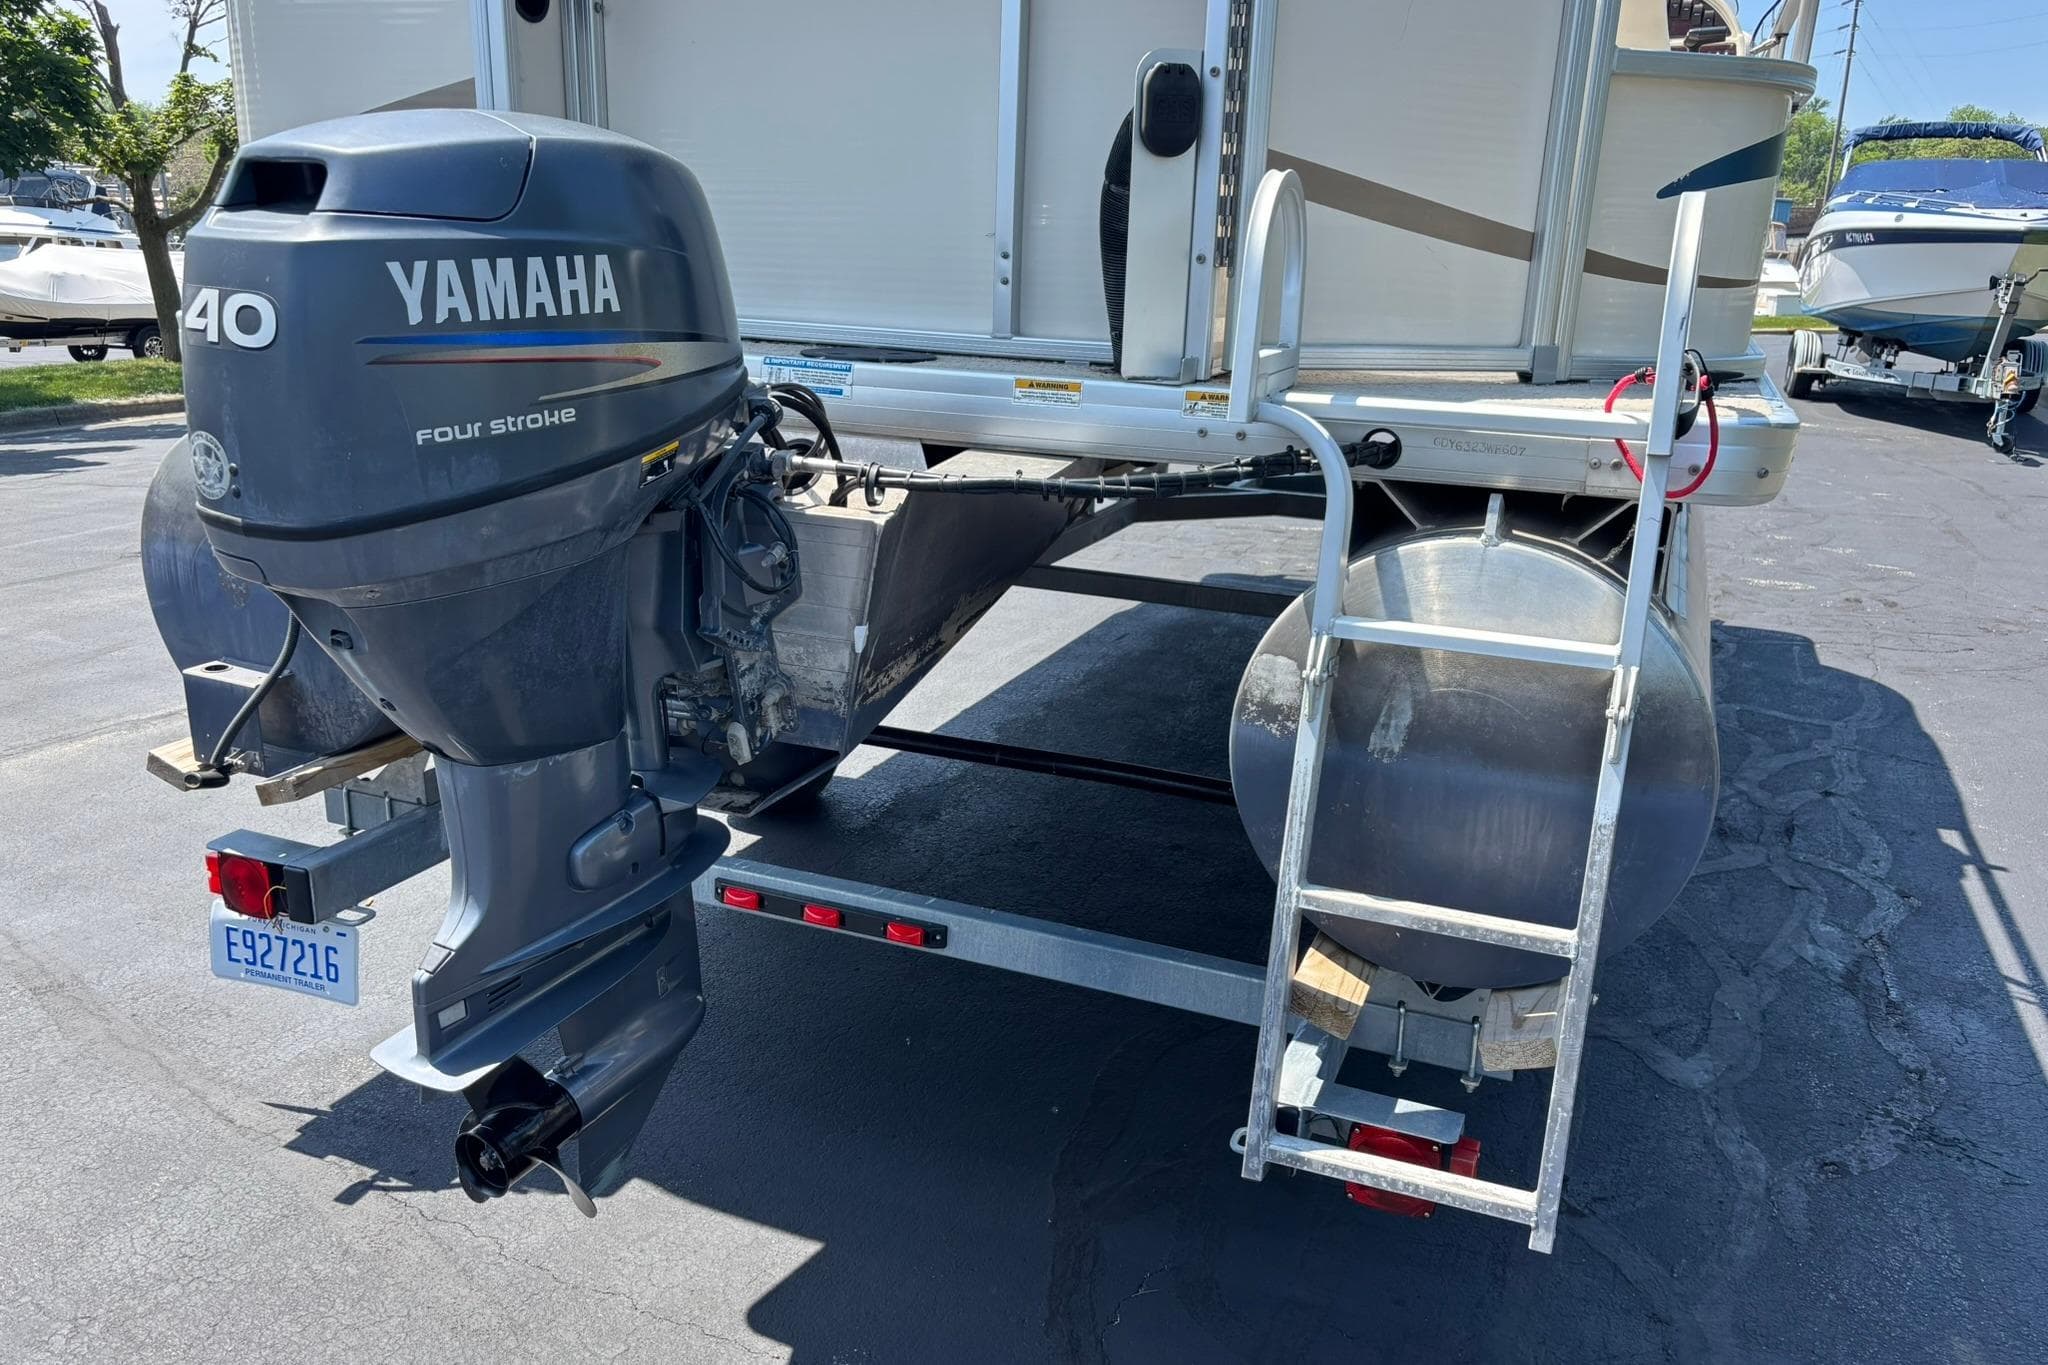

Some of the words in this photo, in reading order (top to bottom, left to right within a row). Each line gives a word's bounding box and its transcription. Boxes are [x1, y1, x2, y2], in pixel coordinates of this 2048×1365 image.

[385, 254, 621, 325] YAMAHA
[184, 288, 277, 349] 40
[1036, 382, 1069, 390] WARNING
[1208, 393, 1230, 401] WARN
[226, 924, 339, 983] E927216
[245, 967, 292, 984] PERMANENT
[294, 977, 326, 992] TRAILER
